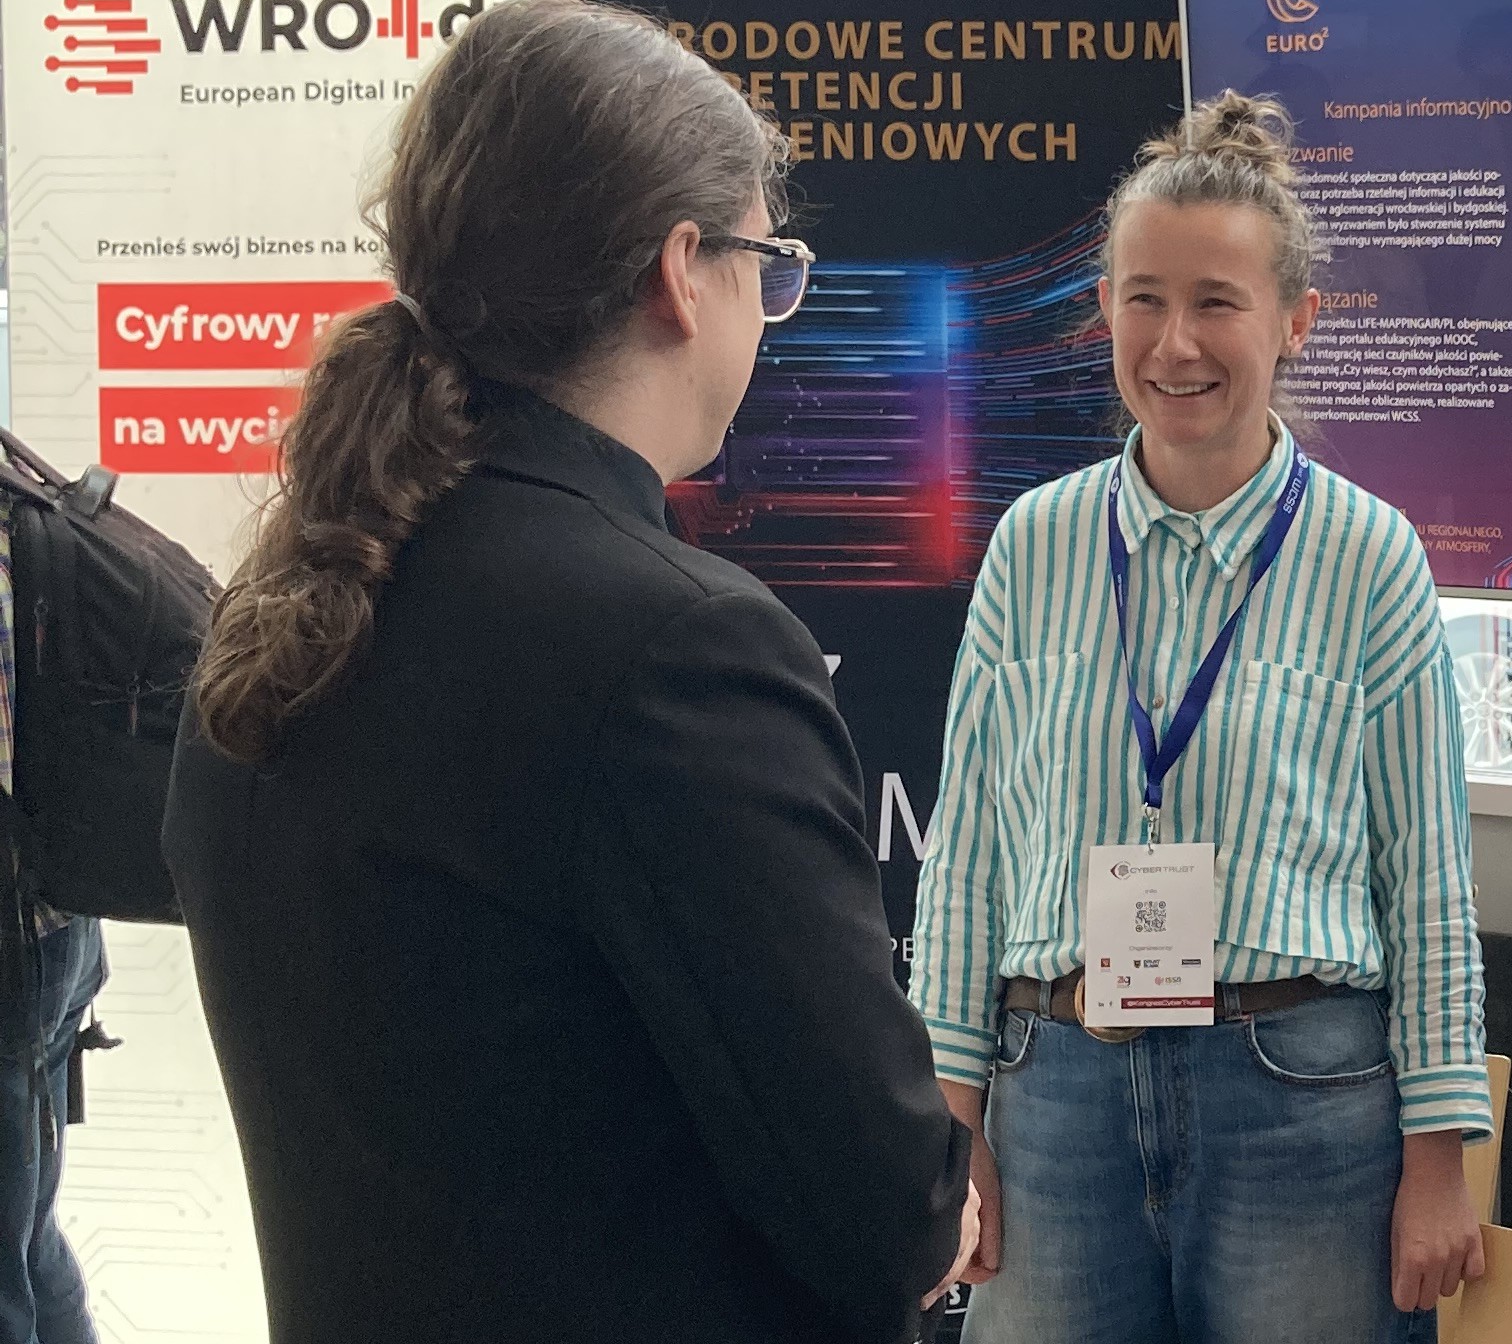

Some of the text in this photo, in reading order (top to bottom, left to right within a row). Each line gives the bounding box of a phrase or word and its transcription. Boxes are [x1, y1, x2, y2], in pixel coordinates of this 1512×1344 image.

[668, 20, 1182, 60] RODOWE CENTRUM
[180, 79, 385, 106] European Digital
[1324, 101, 1402, 122] Kampania
[775, 122, 1077, 162] ENIOWYCH
[1287, 144, 1354, 163] zwanie
[1350, 171, 1397, 186] społeczna
[1399, 171, 1447, 185] dotycząca
[1448, 171, 1482, 185] jakości
[1300, 185, 1505, 201] oraz potrzeba rzetelnej informacji edukacji
[1329, 202, 1508, 216] aglomeracji wrocławskiej bydgoskiej.
[1330, 220, 1386, 233] wyzwaniem
[1387, 218, 1409, 232] było
[1410, 219, 1462, 230] stworzenie
[1464, 219, 1505, 232] systemu
[98, 237, 347, 258] Przenieś swój biznes na
[1372, 234, 1502, 248] wymagającego dużej mocy
[115, 304, 301, 350] Cyfrowy
[1317, 317, 1356, 330] projektu
[1357, 318, 1455, 330] LIFE-MAPPINGAIR/PL
[1339, 333, 1478, 347] portalu edukacyjnego MOOC,
[1316, 349, 1503, 362] integrację sieci czujników jakości powie-
[1392, 366, 1417, 377] czym
[1322, 379, 1487, 393] prognoz jakości powietrza opartych
[1335, 396, 1495, 408] modele obliczeniowe, realizowane
[1303, 410, 1421, 423] superkomputerowi WCSS.
[113, 416, 166, 445] na
